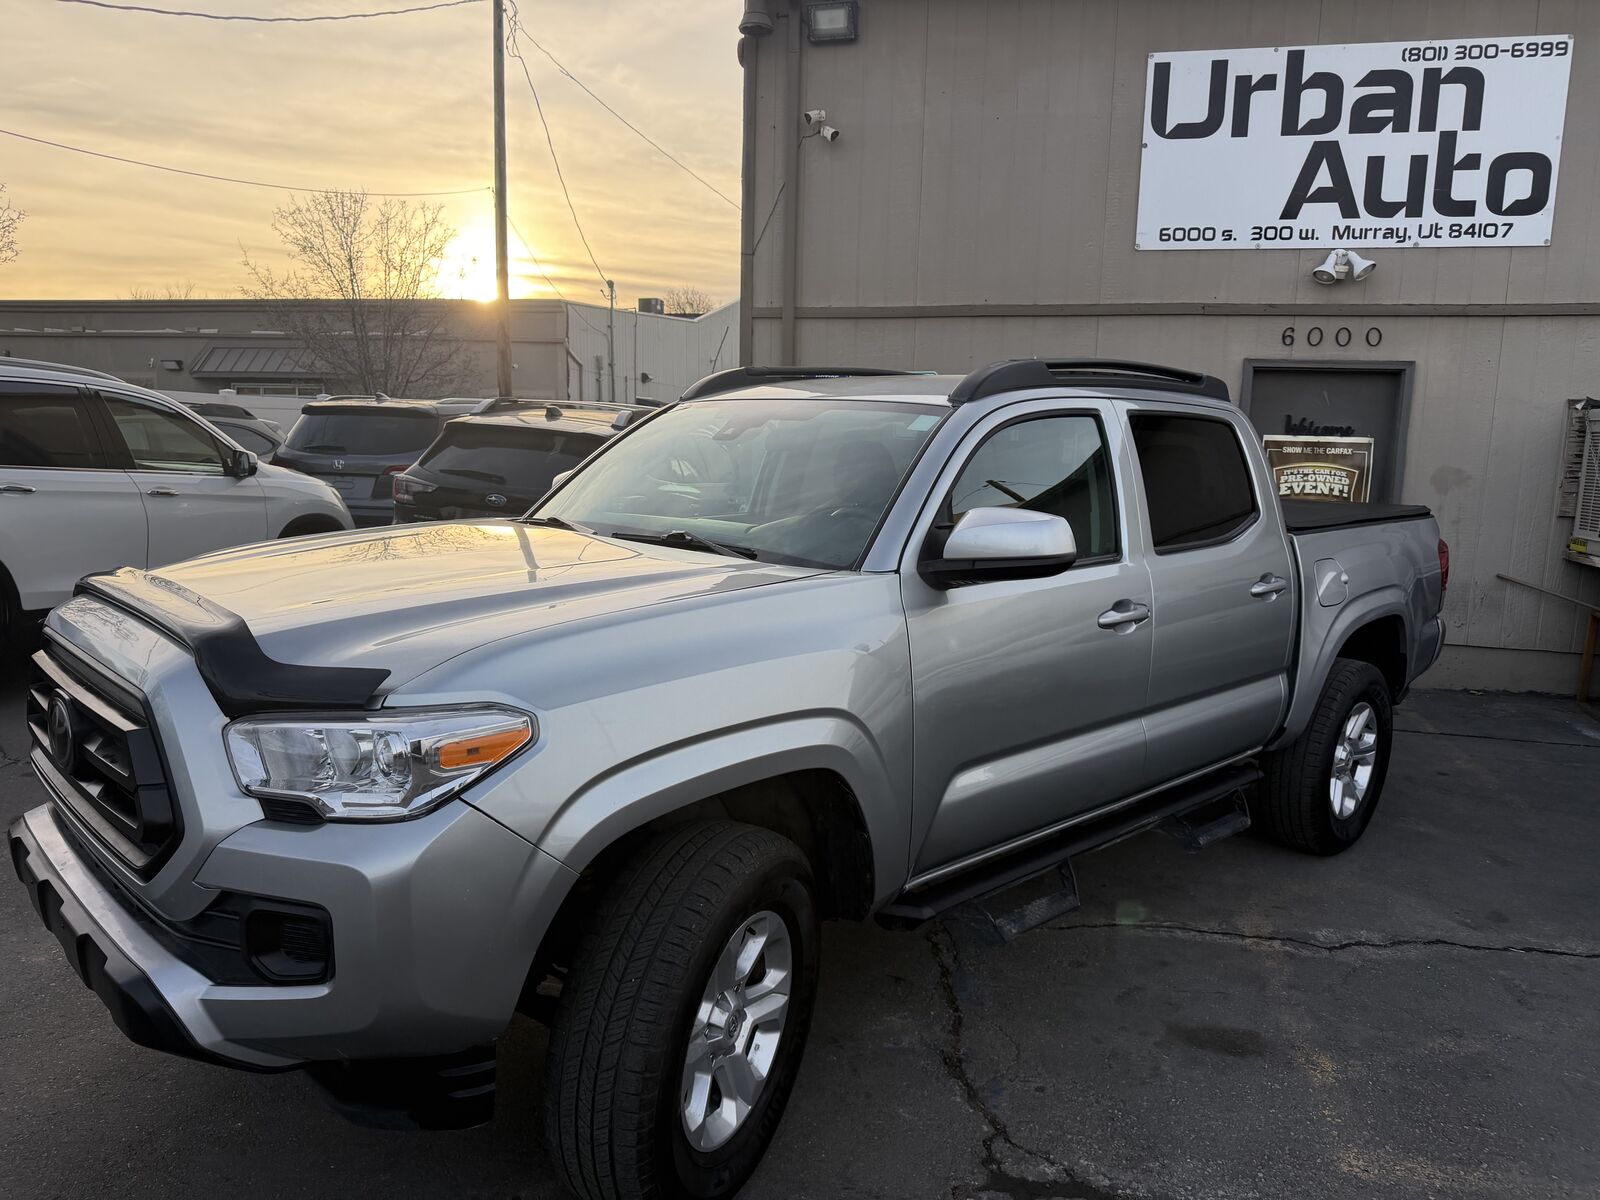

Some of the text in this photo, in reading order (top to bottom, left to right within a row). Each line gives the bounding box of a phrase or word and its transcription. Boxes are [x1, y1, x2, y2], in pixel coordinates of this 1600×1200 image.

[1402, 41, 1568, 62] (801) 300-6999
[1150, 49, 1485, 139] Urban
[1279, 131, 1552, 220] Auto
[1159, 227, 1216, 242] 6000
[1250, 226, 1293, 241] 300
[1332, 225, 1411, 244] Murray,
[1418, 223, 1443, 239] Ut
[1449, 222, 1514, 239] 84107
[1282, 327, 1382, 347] 6000
[1282, 446, 1302, 454] SHOW
[1314, 447, 1325, 455] THE
[1279, 474, 1350, 485] PRE-OWNED
[1279, 482, 1349, 498] EVENT!
